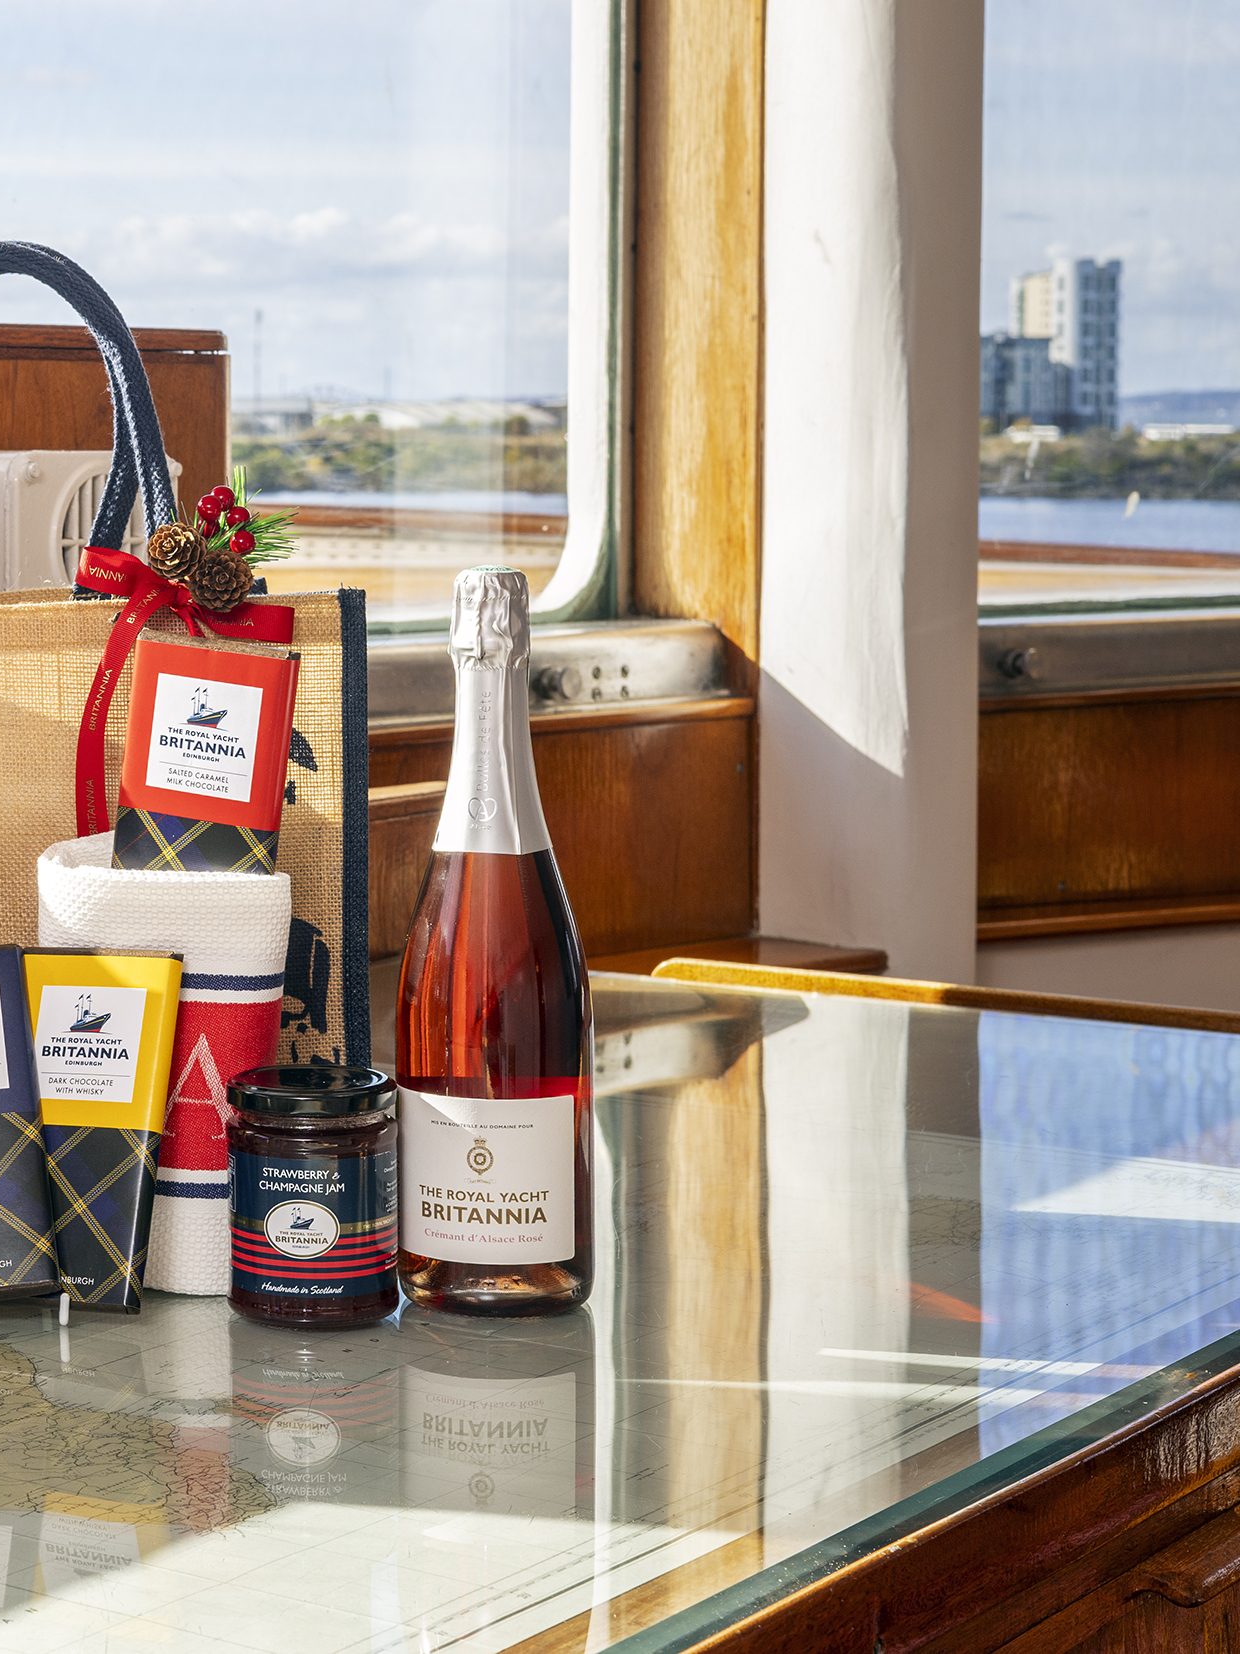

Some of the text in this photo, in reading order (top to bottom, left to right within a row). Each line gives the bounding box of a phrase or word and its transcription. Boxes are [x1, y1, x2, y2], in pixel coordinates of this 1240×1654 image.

[88, 669, 113, 731] BRITANNIA
[168, 727, 240, 743] THE ROYAL YACHT
[159, 735, 246, 759] BRITANNIA
[183, 752, 220, 762] EDINBURGH
[169, 768, 229, 784] SALTED CARAMEL
[167, 778, 228, 793] MILK CHOCOLATE
[68, 1037, 93, 1045] ROYAL
[96, 1038, 122, 1046] YACHT
[41, 1045, 129, 1060] BRITANNIA
[48, 1077, 114, 1087] DARK CHOCOLATE
[76, 1087, 104, 1096] WHISKY
[263, 1167, 329, 1180] STRAWBERRY
[259, 1181, 345, 1195] CHAMPAGNE JAM
[419, 1185, 549, 1202] THE ROYAL YACHT
[421, 1201, 547, 1224] BRITANNIA
[275, 1236, 328, 1245] BRITANNIA
[424, 1228, 543, 1243] Crémant d'Alsace Rosé
[60, 1276, 94, 1286] NBURGH
[261, 1281, 300, 1294] Handmade
[310, 1285, 344, 1294] Scotland
